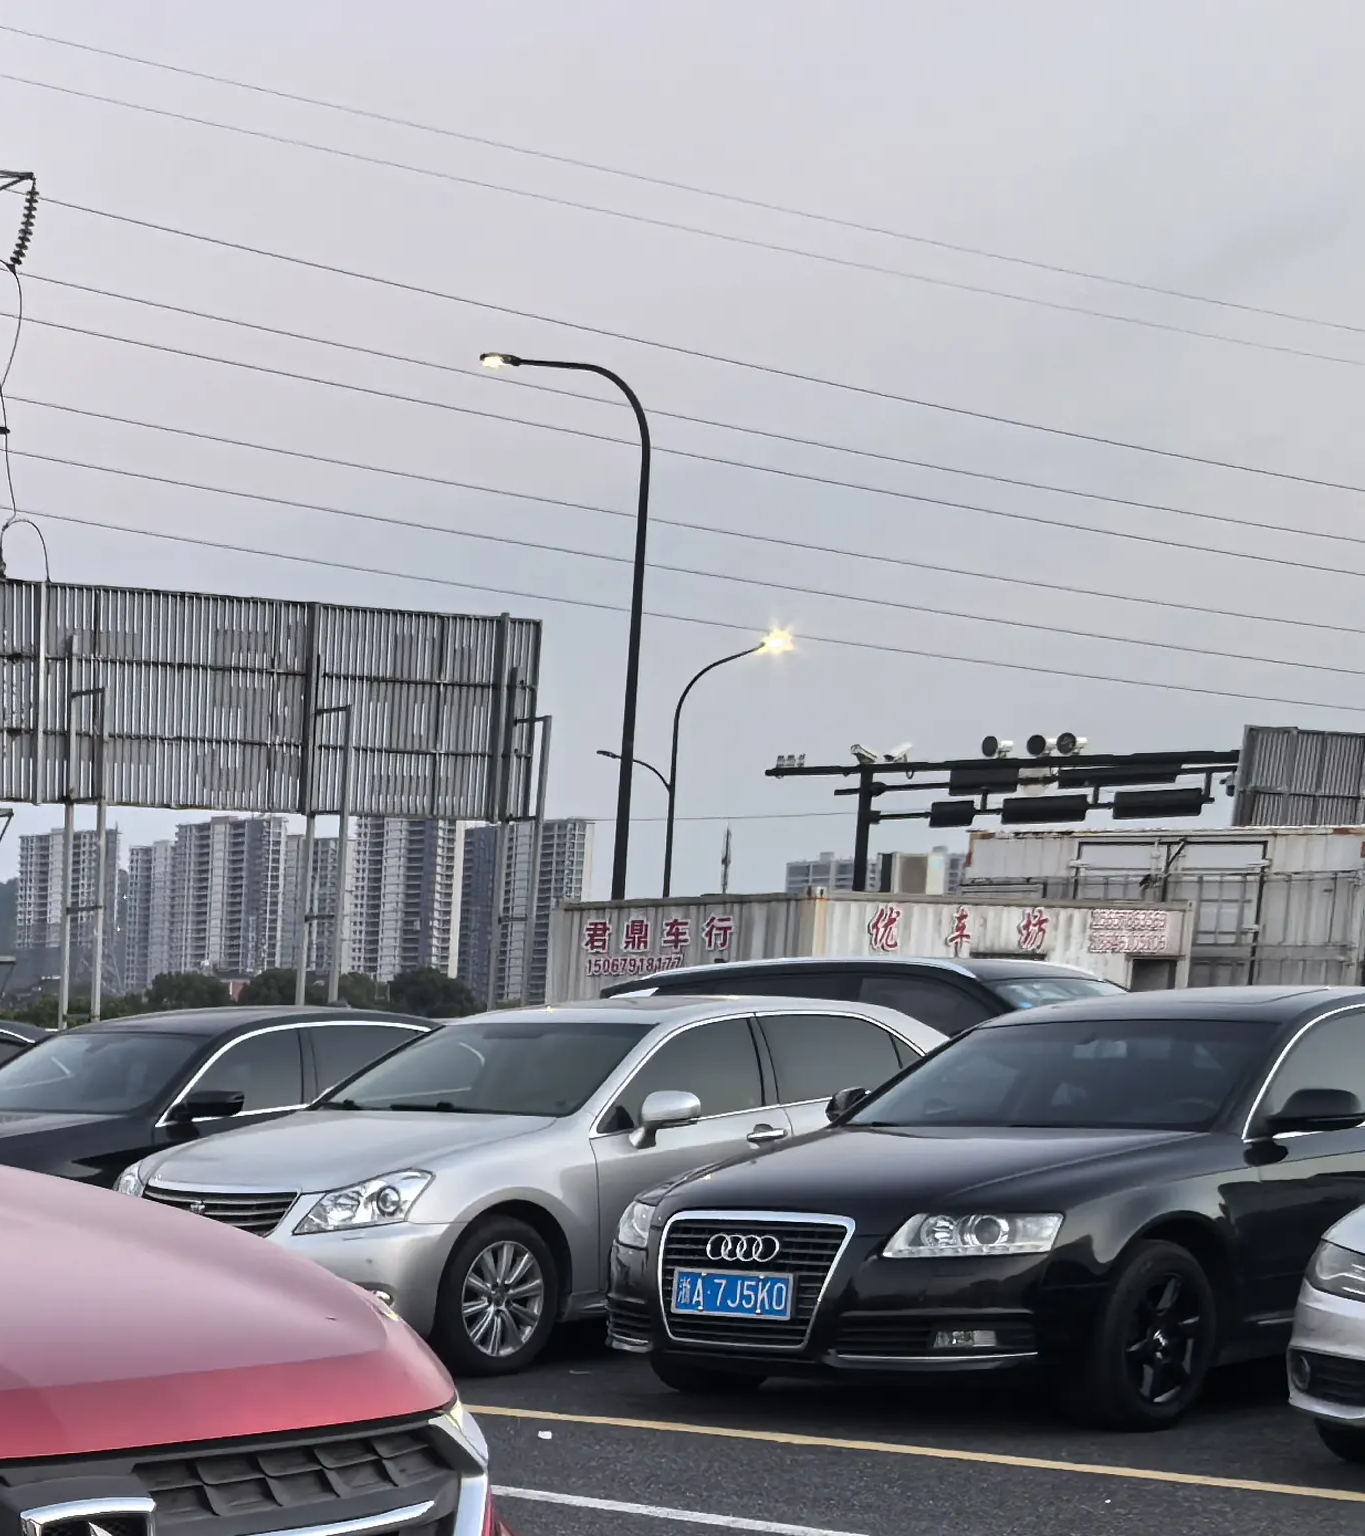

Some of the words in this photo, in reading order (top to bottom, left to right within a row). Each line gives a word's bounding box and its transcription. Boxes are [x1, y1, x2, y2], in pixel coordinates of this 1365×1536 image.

[583, 915, 734, 952] 君鼎车行
[869, 905, 1049, 957] 优车坊
